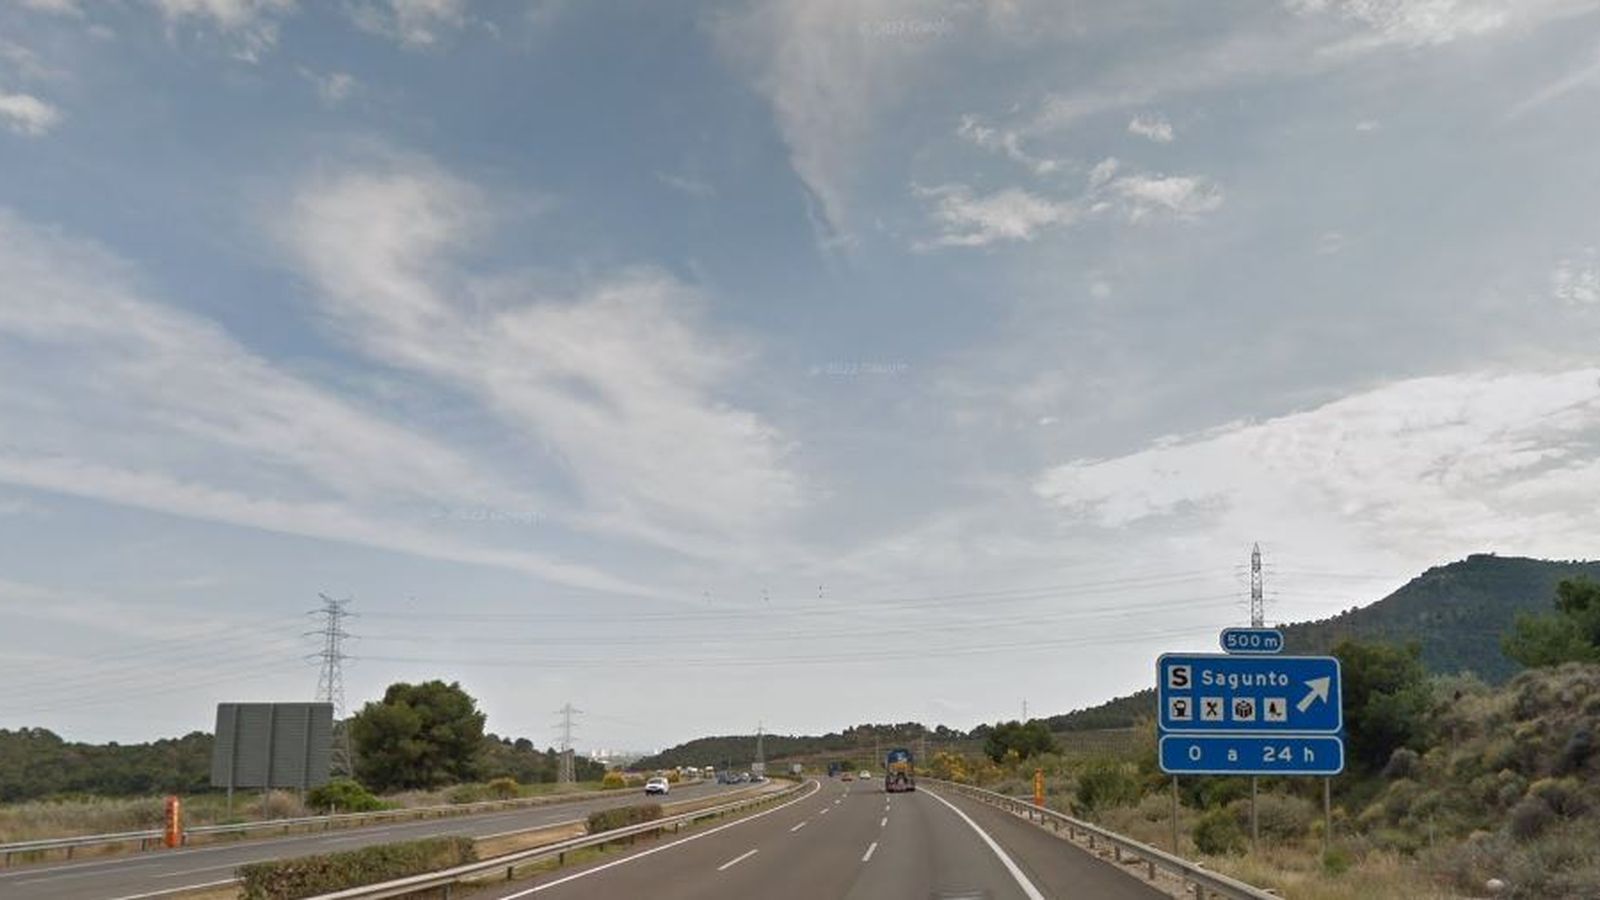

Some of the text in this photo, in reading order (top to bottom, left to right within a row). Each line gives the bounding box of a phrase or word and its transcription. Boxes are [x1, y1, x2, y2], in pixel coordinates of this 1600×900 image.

[1227, 634, 1278, 648] 500 m
[1172, 667, 1289, 689] S Sagunto
[1188, 745, 1315, 763] 0 a 24 h
